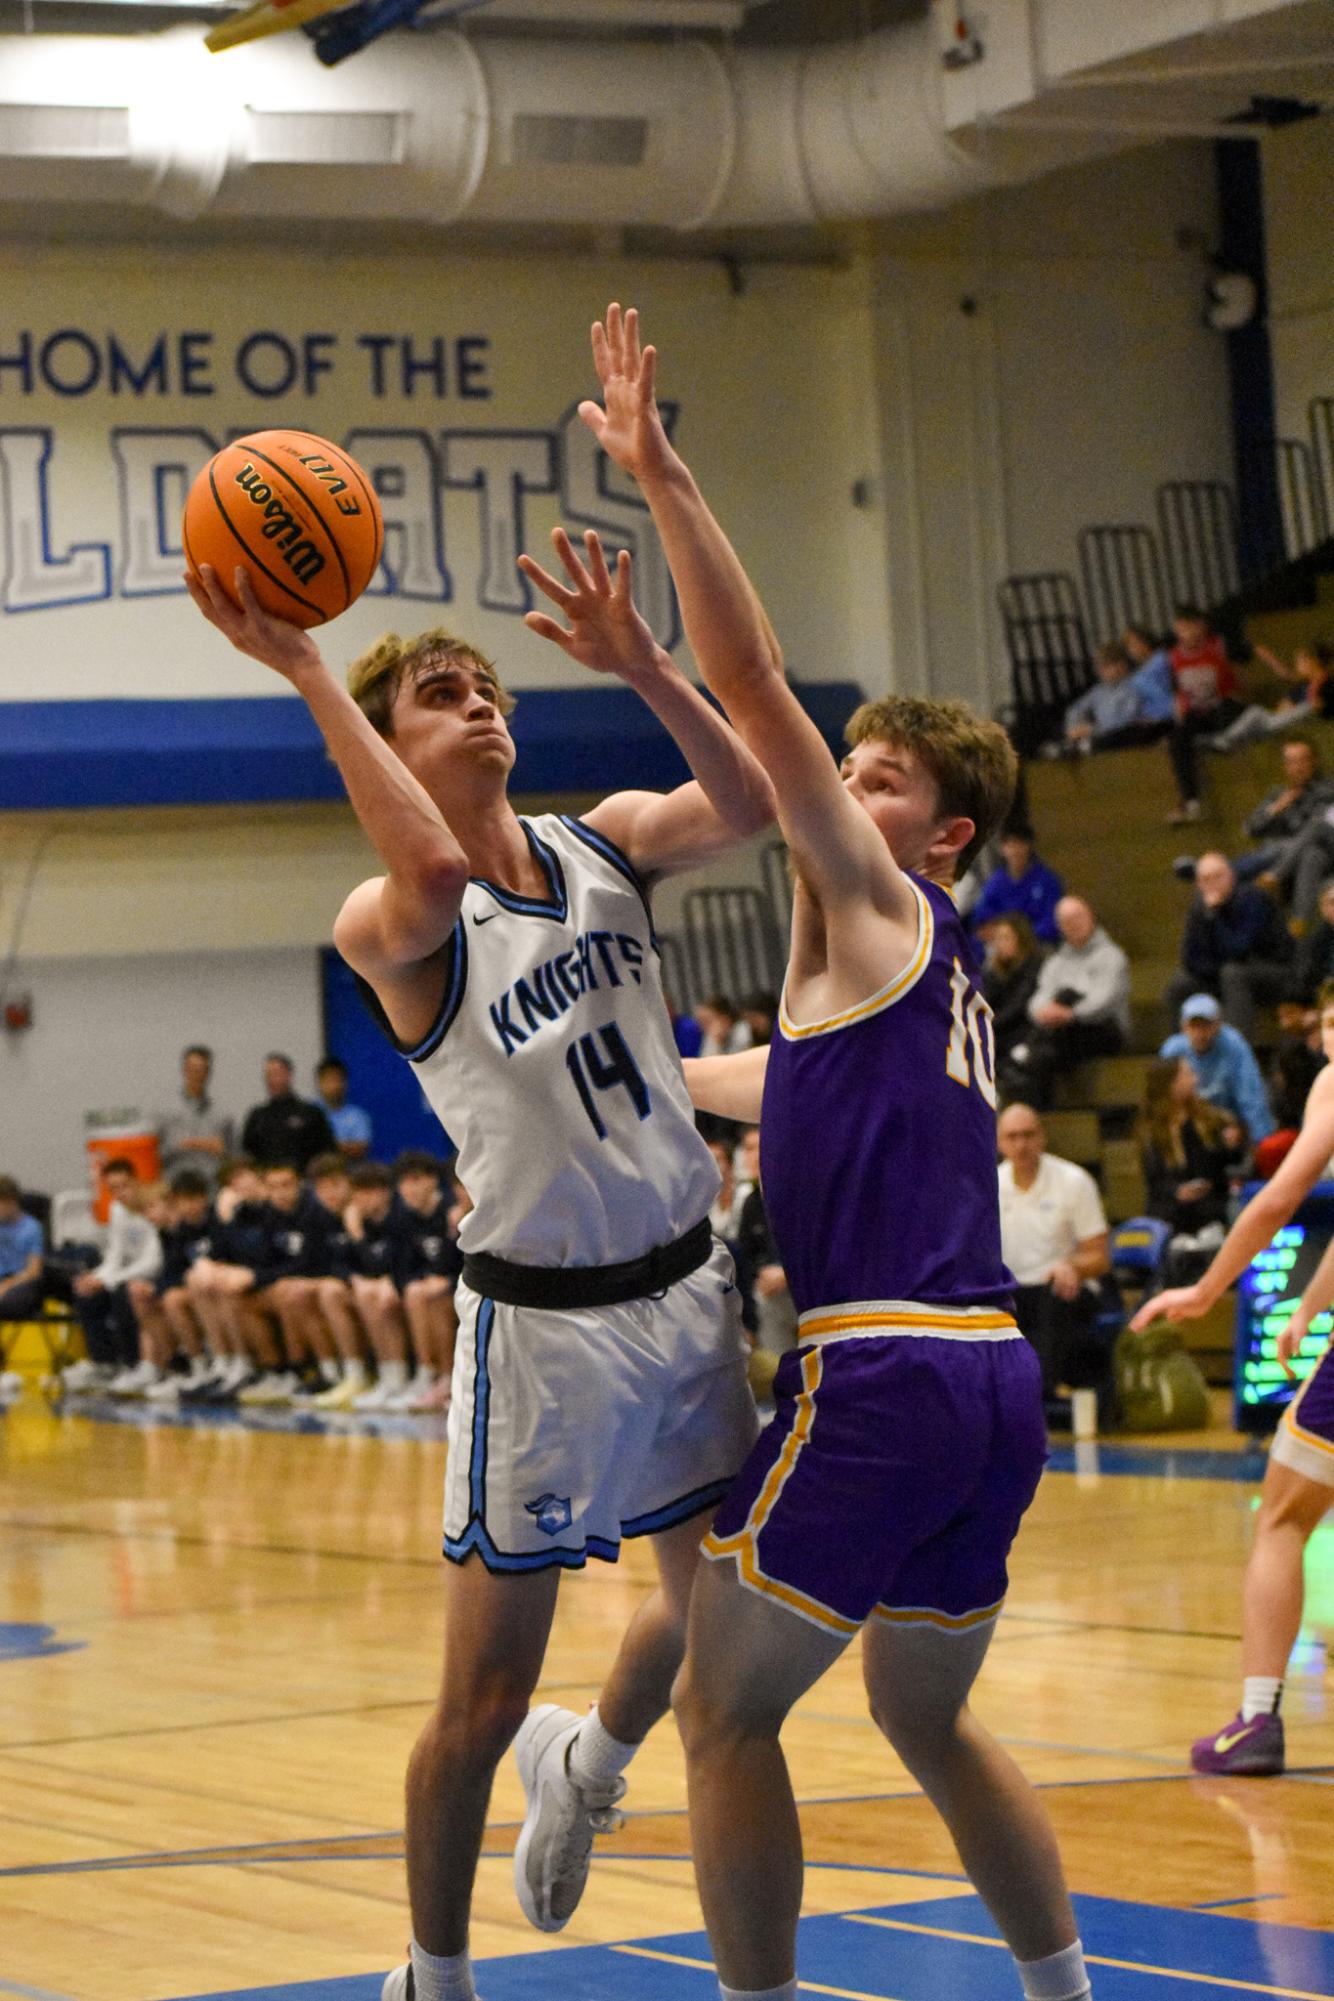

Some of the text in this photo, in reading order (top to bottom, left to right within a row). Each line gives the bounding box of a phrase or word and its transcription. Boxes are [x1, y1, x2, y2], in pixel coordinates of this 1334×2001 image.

[0, 329, 491, 401] HOME OF THE
[234, 461, 326, 587] Wilson
[488, 931, 643, 1058] KNIGHTS
[945, 955, 998, 1112] 10
[566, 1020, 650, 1142] 14
